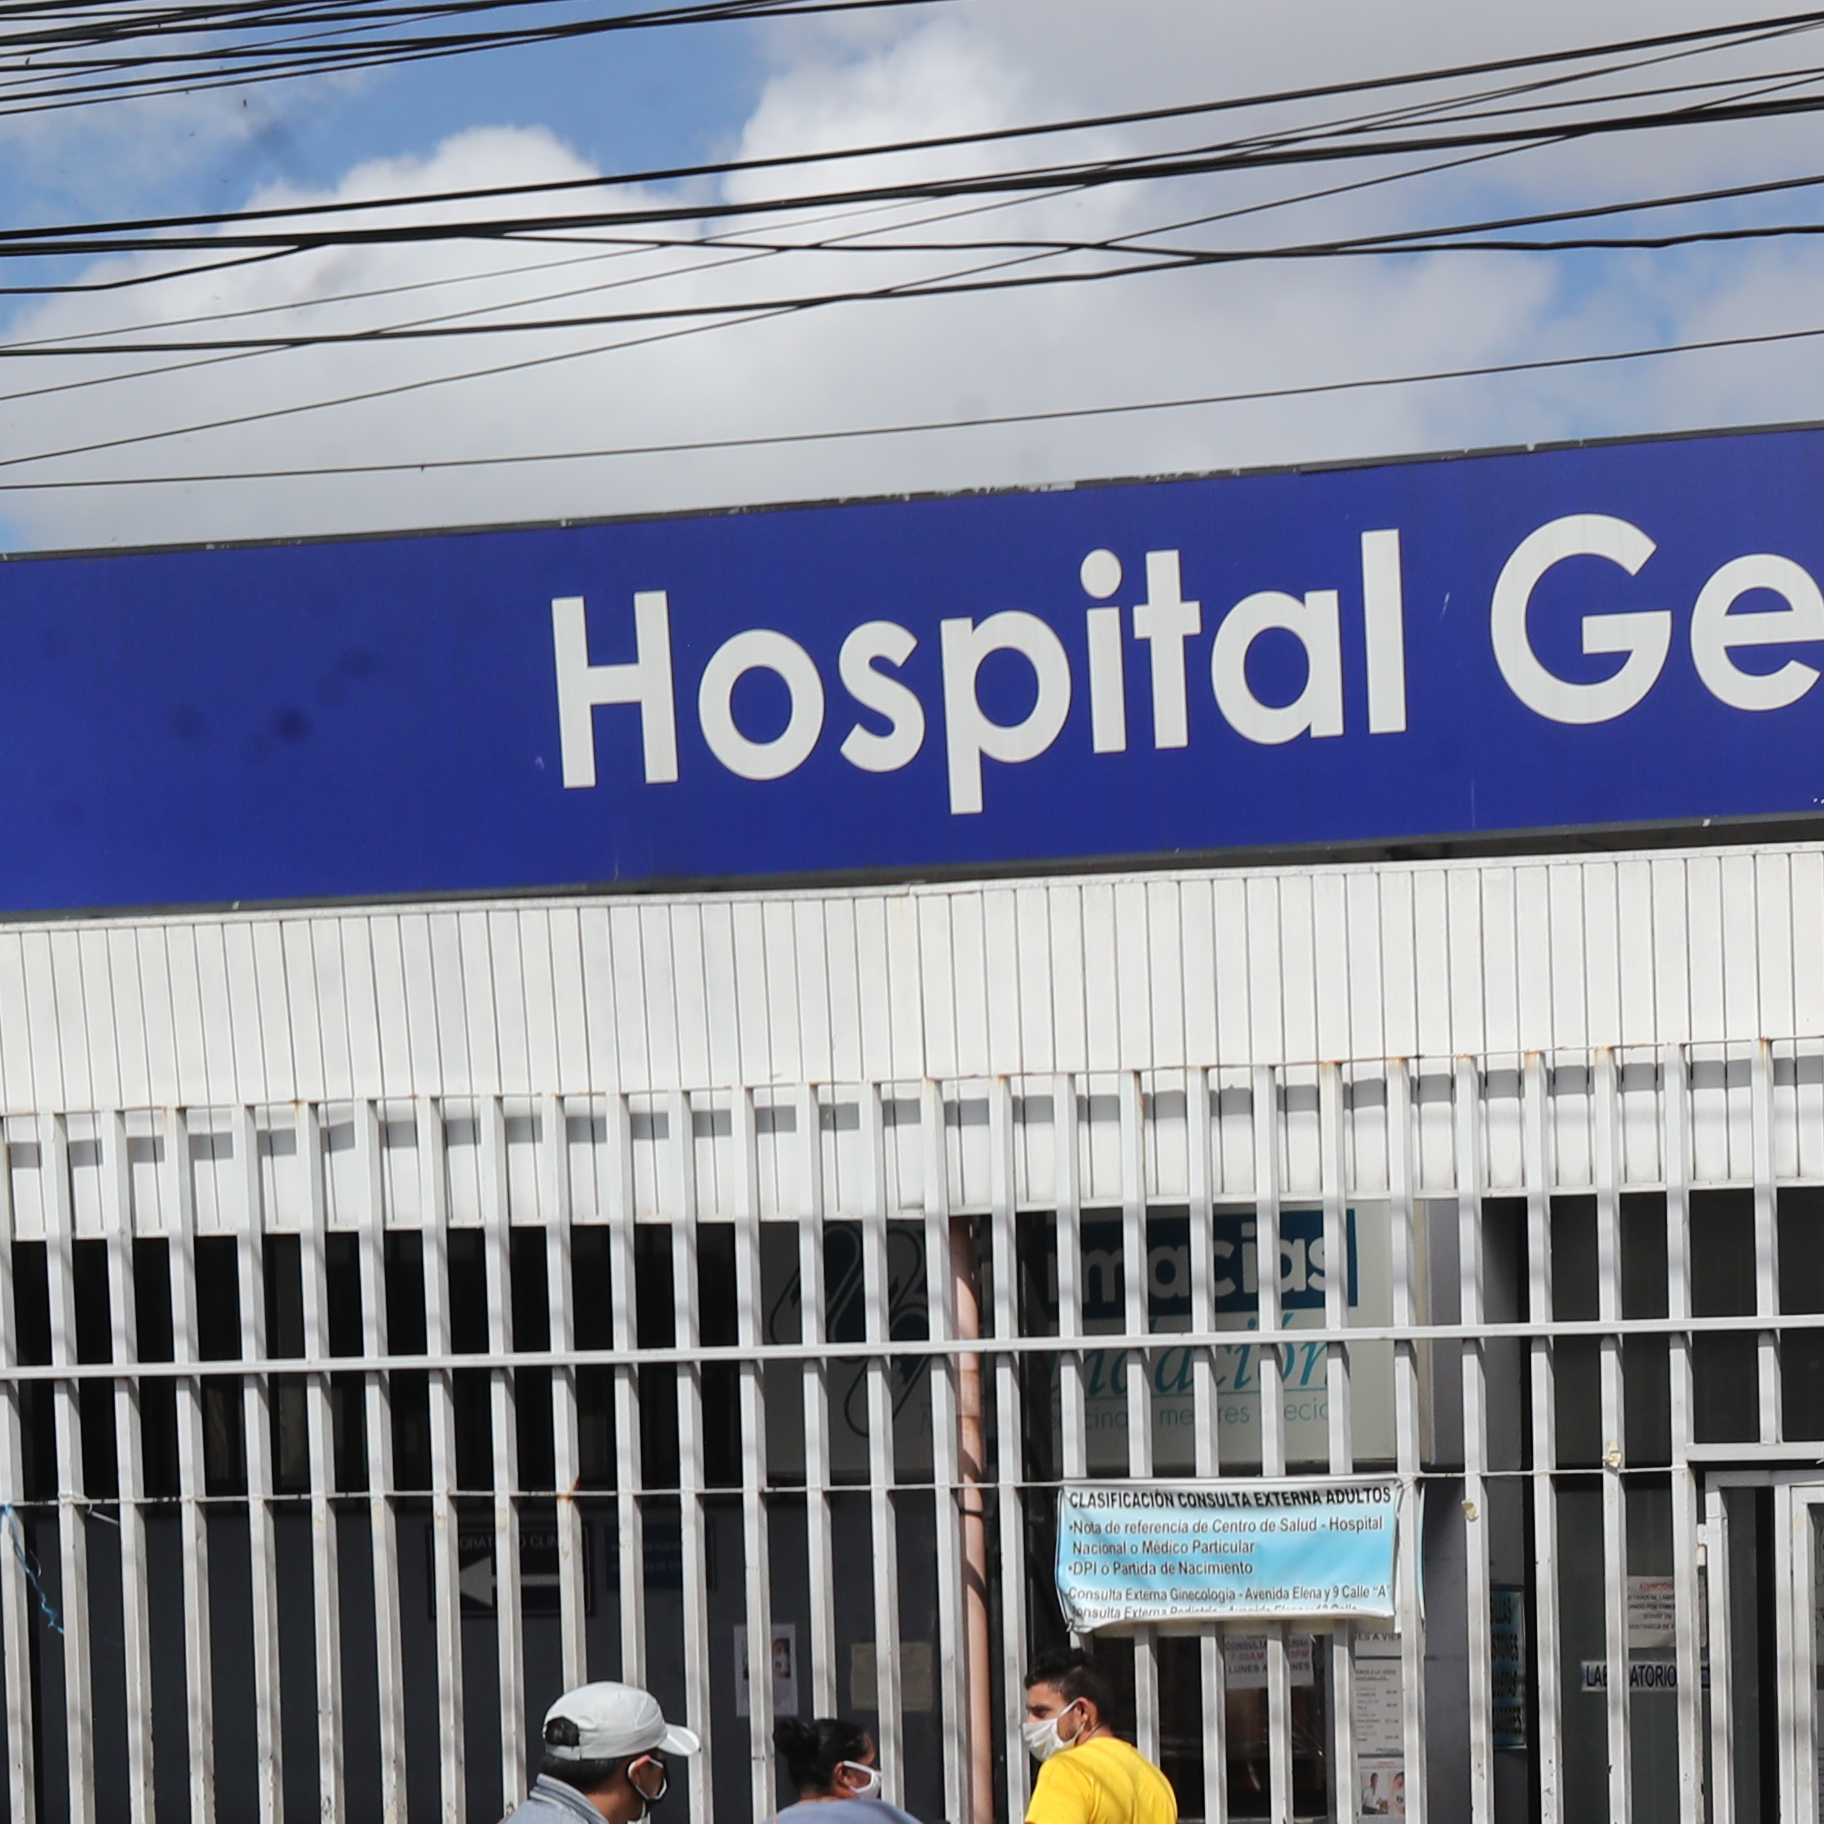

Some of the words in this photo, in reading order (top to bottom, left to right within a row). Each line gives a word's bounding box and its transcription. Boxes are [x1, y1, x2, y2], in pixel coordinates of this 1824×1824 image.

[552, 528, 1406, 814] Hospital
[1069, 1488, 1174, 1509] CLASIFICACIÓN
[1177, 1491, 1250, 1508] CONSULTA
[1254, 1489, 1322, 1506] EXTERNA
[1326, 1487, 1392, 1504] ADULTOS
[1104, 1519, 1122, 1534] de
[1124, 1519, 1185, 1535] referencia
[1187, 1519, 1209, 1534] de
[1212, 1518, 1256, 1534] Centro
[1259, 1518, 1276, 1533] de
[1279, 1516, 1318, 1532] Salud
[1329, 1515, 1383, 1532] Hospital
[1072, 1540, 1127, 1555] Nacional
[1130, 1545, 1139, 1555] o
[1142, 1539, 1189, 1554] Médico
[1192, 1539, 1256, 1554] Particular
[1113, 1562, 1157, 1575] Partida
[1160, 1562, 1176, 1575] de
[1178, 1561, 1254, 1575] Nacimiento
[1125, 1587, 1168, 1601] Externa
[1245, 1585, 1290, 1600] Avenida
[1292, 1585, 1322, 1599] Elena
[1324, 1590, 1331, 1602] y
[1341, 1584, 1370, 1598] Calle
